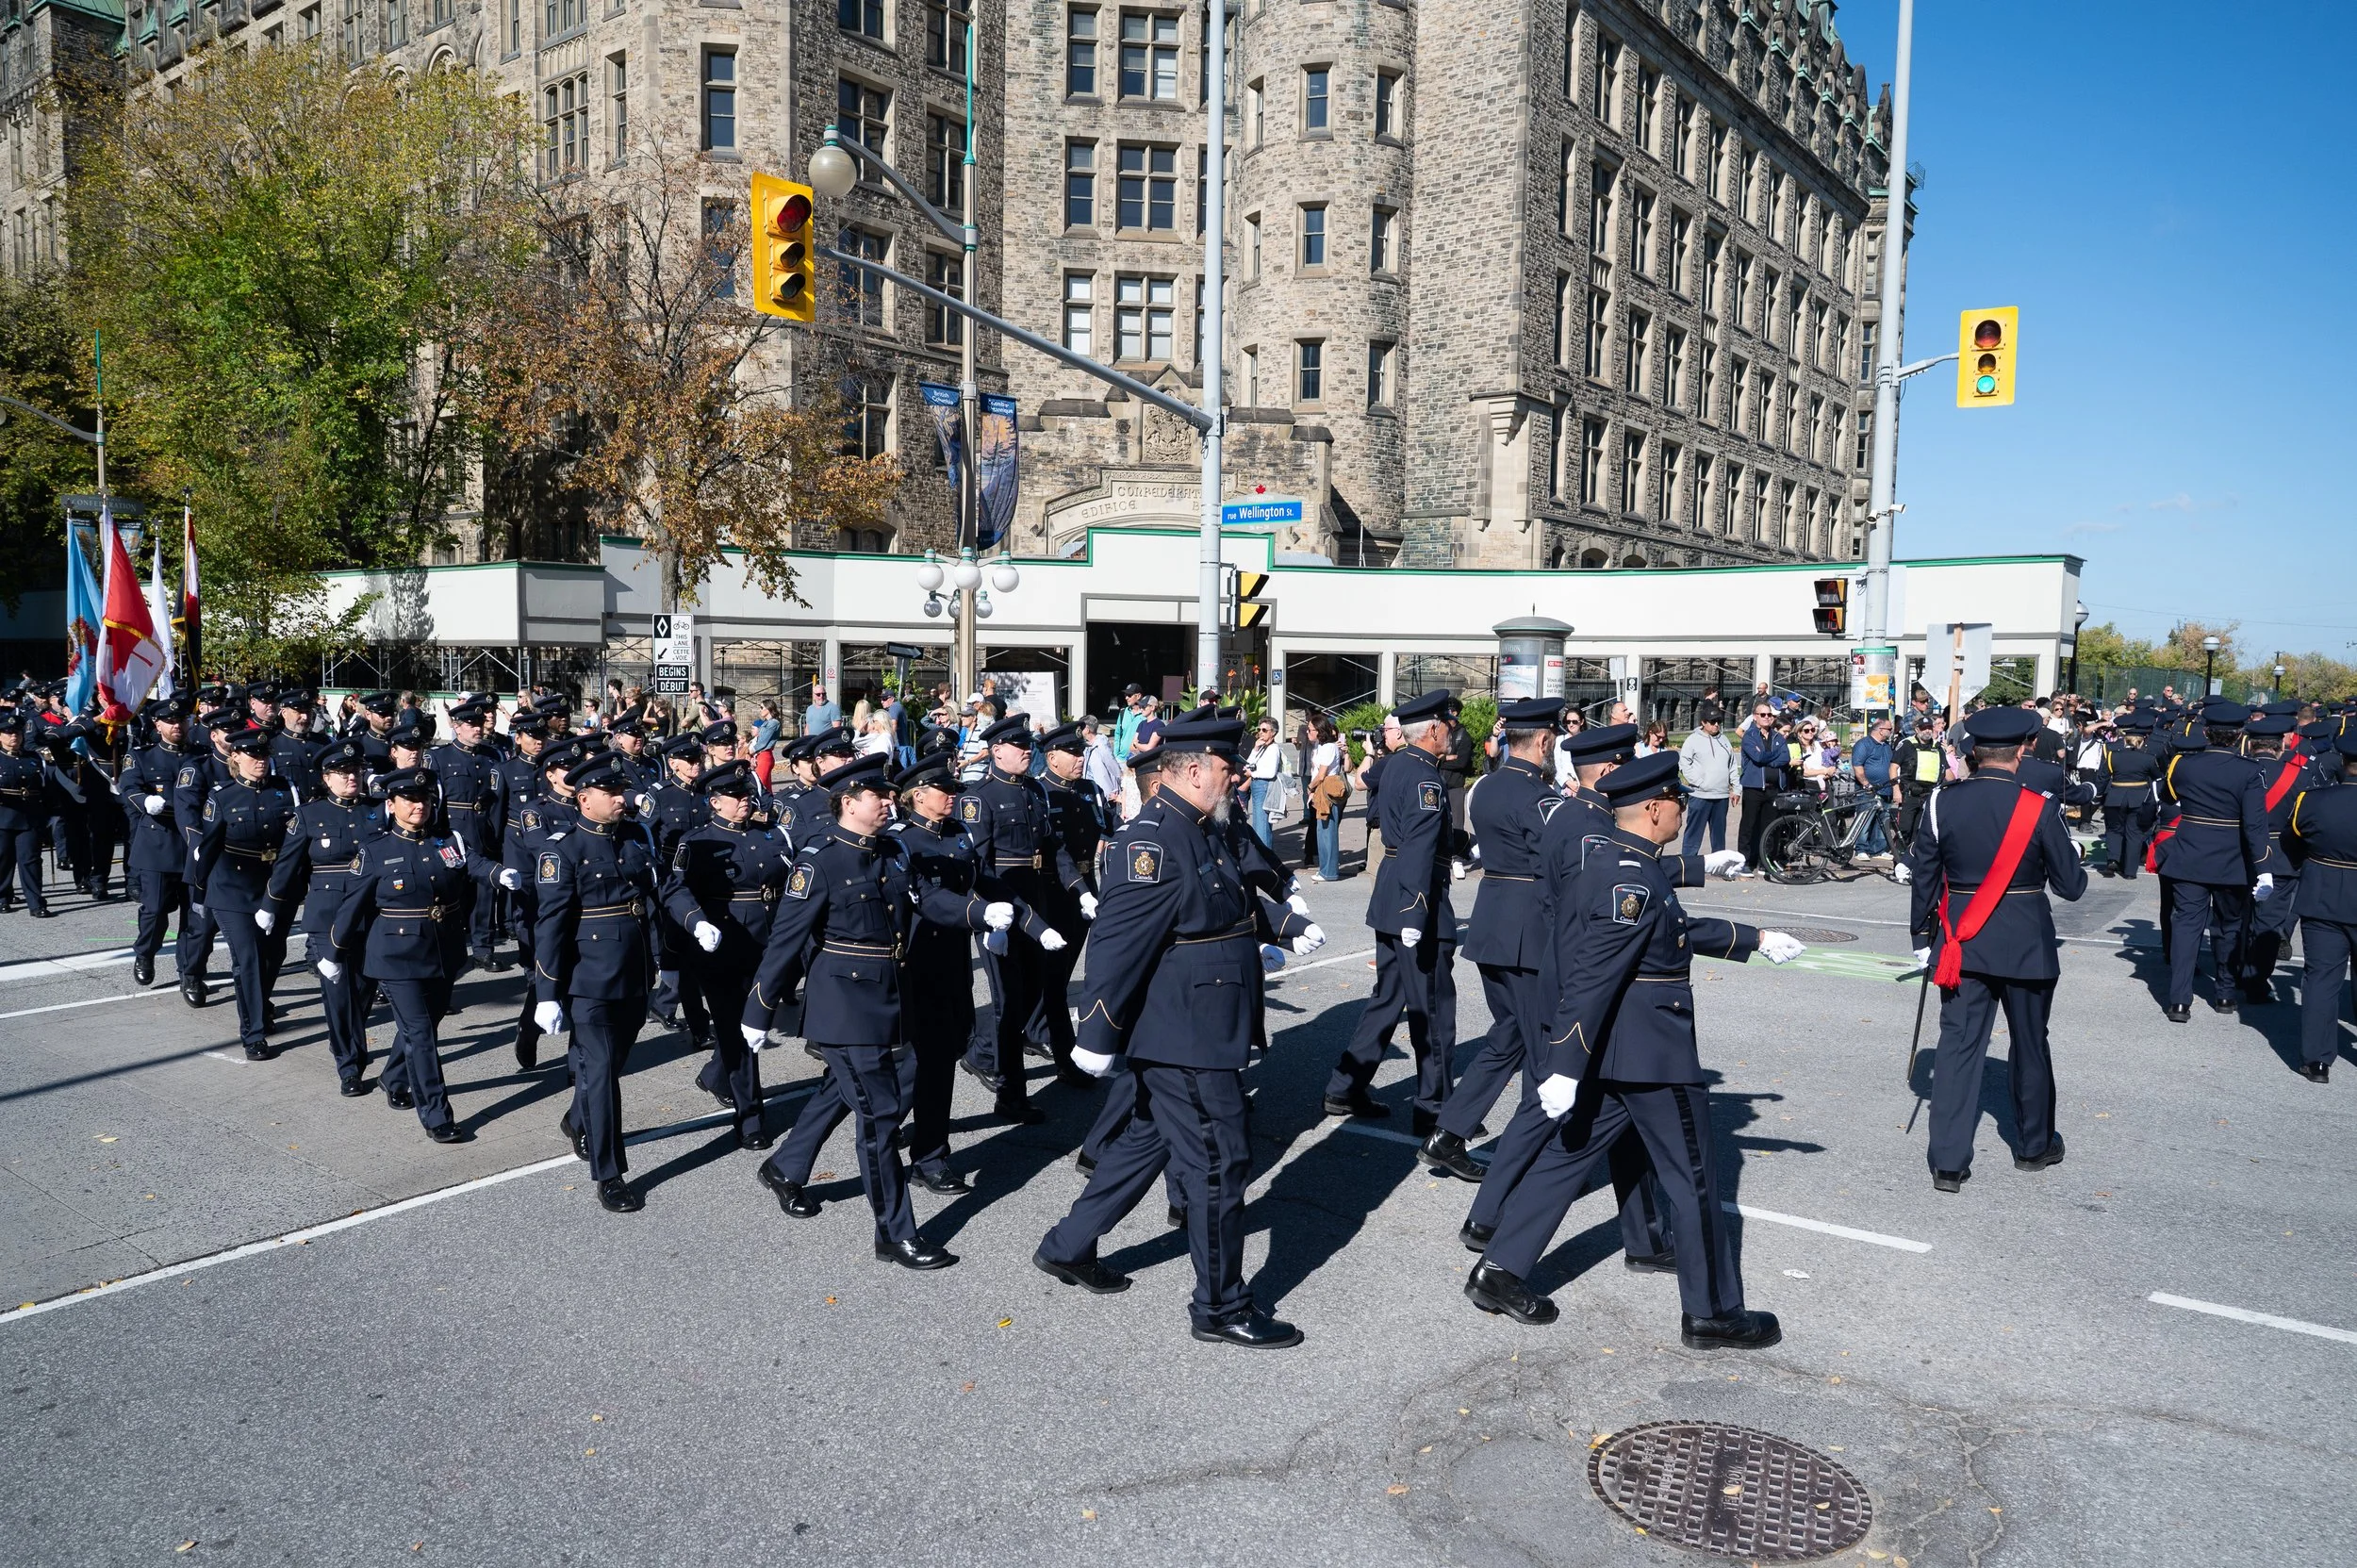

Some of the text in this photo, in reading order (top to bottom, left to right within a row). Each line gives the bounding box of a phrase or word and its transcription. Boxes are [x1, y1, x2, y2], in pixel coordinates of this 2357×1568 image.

[1239, 505, 1285, 520] Wellington
[659, 667, 686, 677] BEGINS
[660, 680, 685, 691] DÉBUT
[1722, 1464, 1742, 1510] TELCOM
